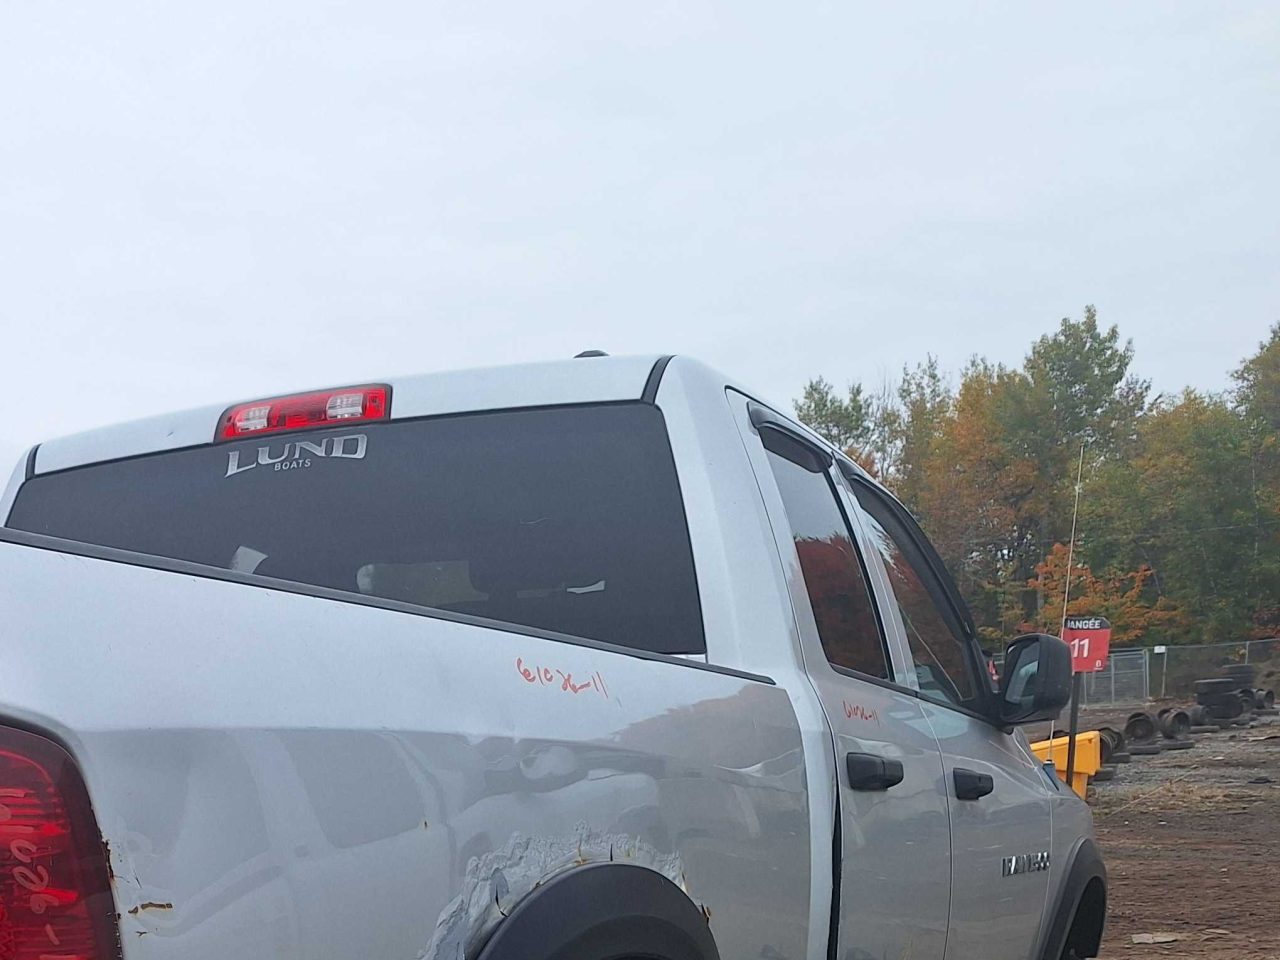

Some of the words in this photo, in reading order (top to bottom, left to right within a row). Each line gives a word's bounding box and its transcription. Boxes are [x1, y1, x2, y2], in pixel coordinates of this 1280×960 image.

[224, 434, 368, 478] LUND
[274, 458, 312, 471] BOATS
[1071, 638, 1090, 658] 11
